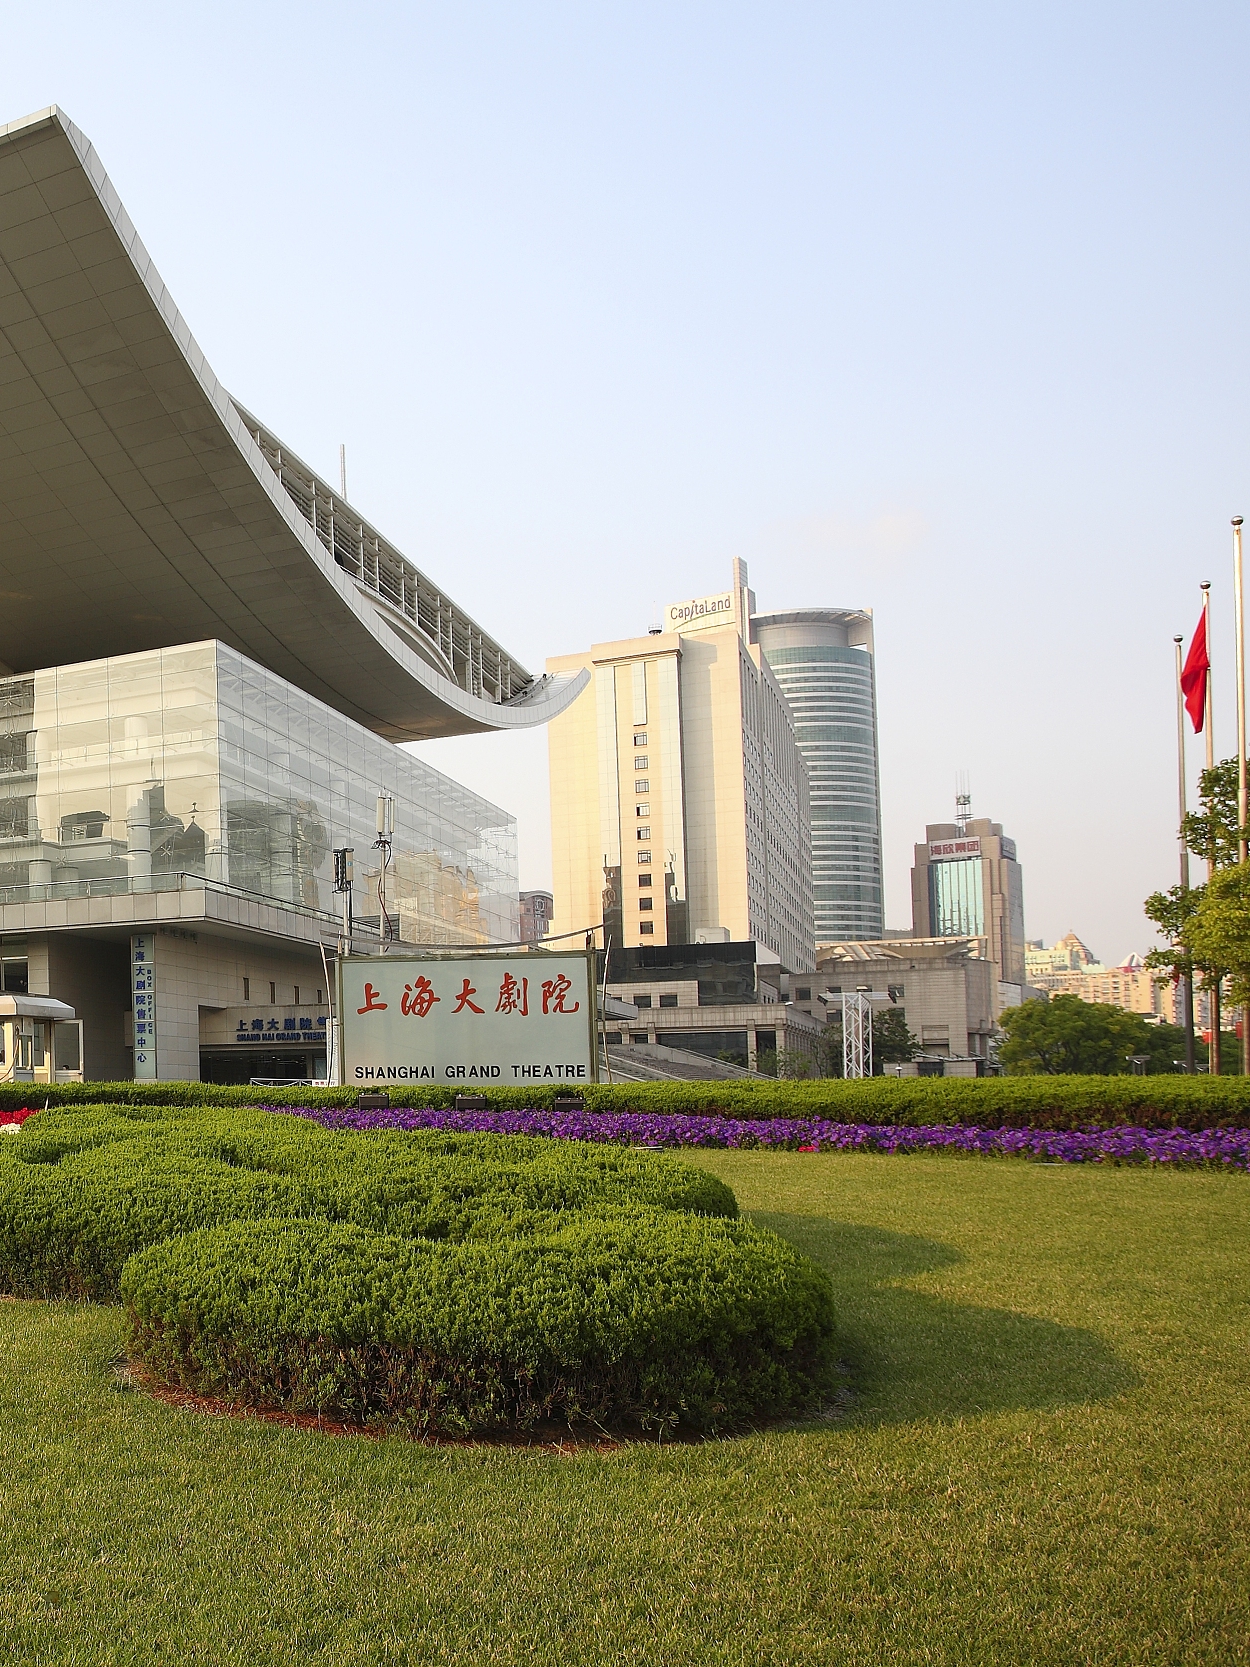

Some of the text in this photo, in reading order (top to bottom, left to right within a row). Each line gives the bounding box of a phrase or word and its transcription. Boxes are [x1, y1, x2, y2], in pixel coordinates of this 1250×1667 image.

[670, 595, 731, 620] CapitaLand
[930, 841, 979, 856] 海欣集团
[135, 938, 147, 1063] 上海大剧院售票中心
[356, 972, 580, 1018] 上海大劇院
[275, 1032, 301, 1041] GRAND
[354, 1064, 586, 1079] SHANGHAI GRAND THEATRE
